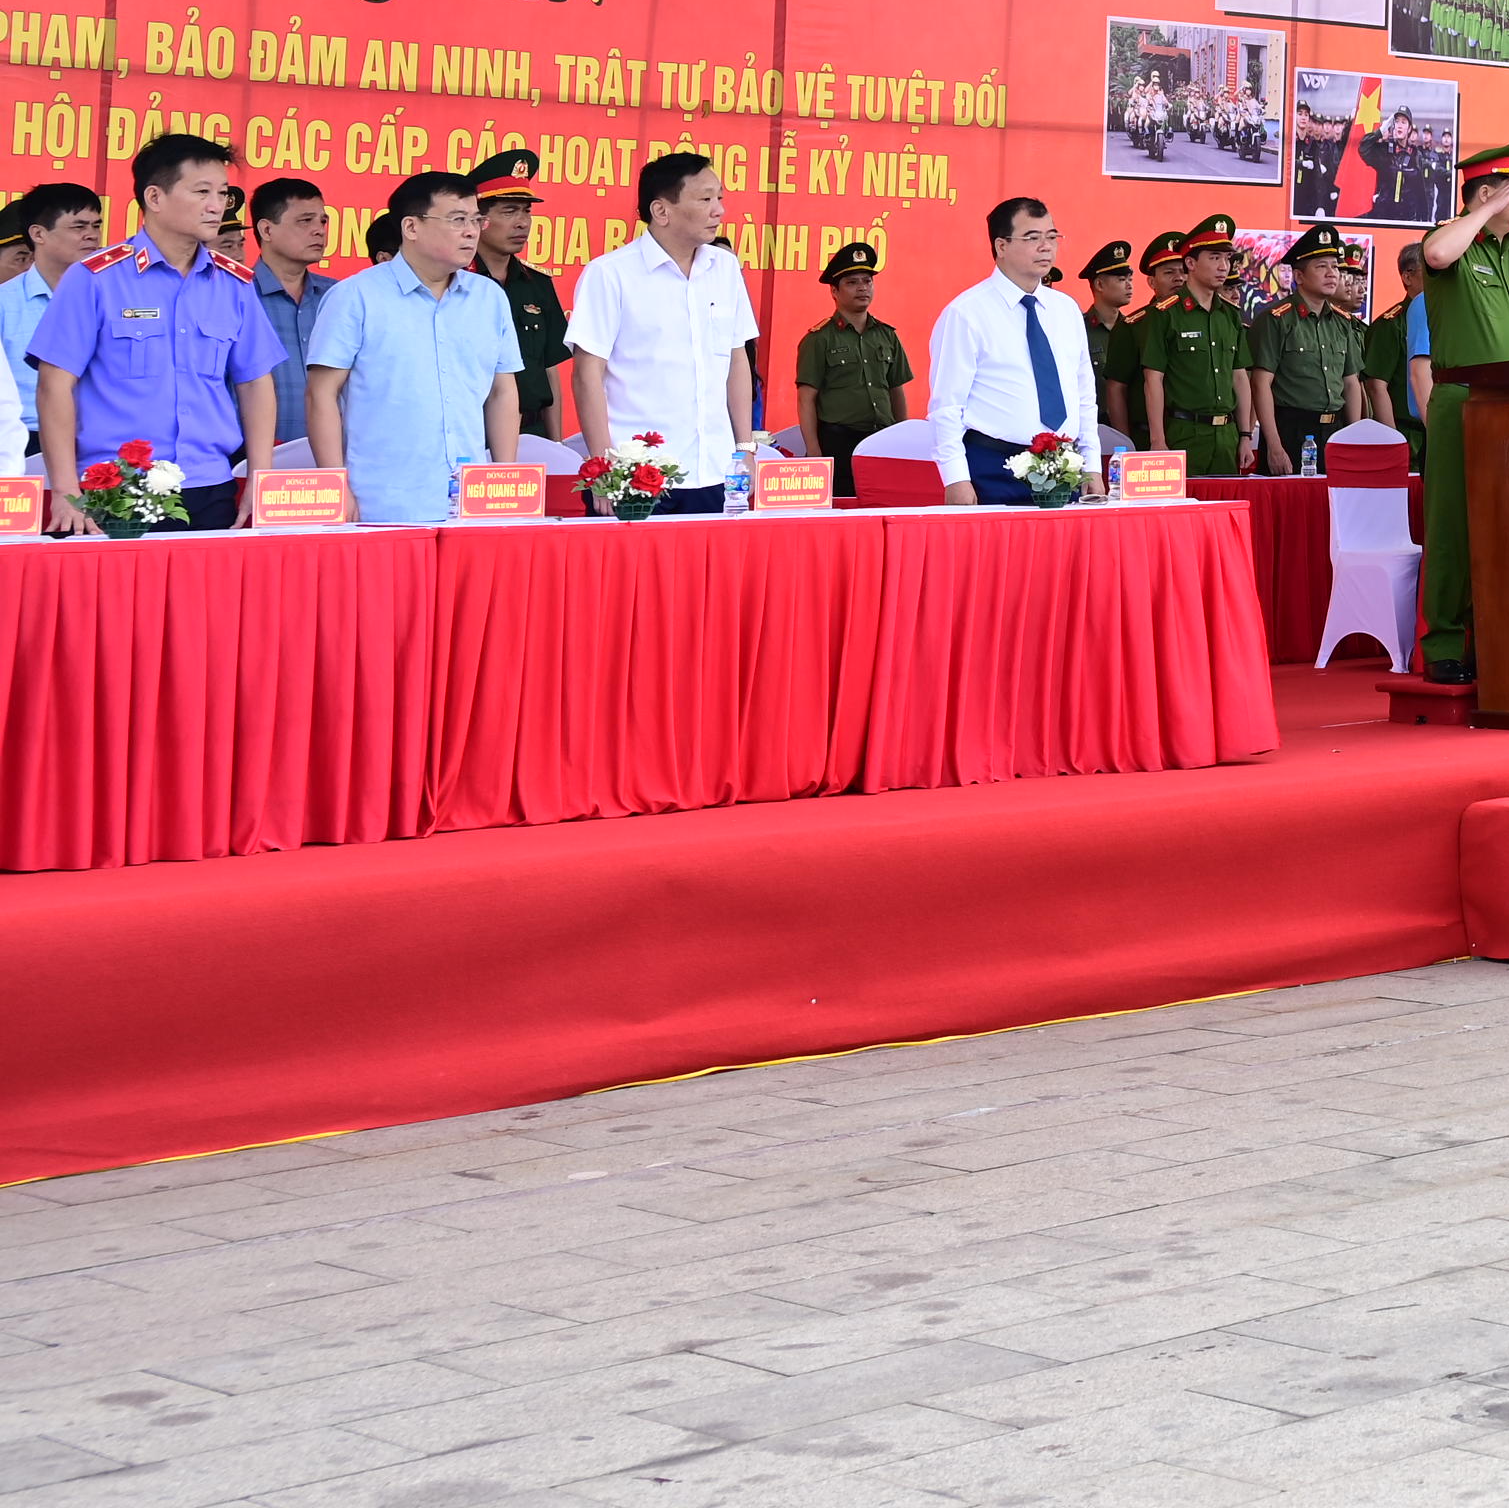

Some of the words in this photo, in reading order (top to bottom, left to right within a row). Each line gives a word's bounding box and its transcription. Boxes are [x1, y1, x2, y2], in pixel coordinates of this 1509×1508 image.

[145, 7, 235, 80] BẢO
[249, 16, 347, 88] ĐẢM
[359, 39, 419, 92] AN
[431, 45, 541, 106] NINH,
[555, 48, 646, 117] TRẬT
[713, 52, 783, 116] BẢO
[795, 63, 835, 128] VỆ
[847, 69, 945, 133] TUYỆT
[953, 68, 1007, 128] ĐỐI
[1302, 73, 1329, 89] VOV
[12, 92, 90, 169] HỘI
[245, 107, 332, 169] CÁC
[538, 132, 647, 196] HOẠT
[758, 130, 797, 194] LỄ
[808, 134, 859, 198] KỶ
[862, 144, 957, 207] NIỆM,
